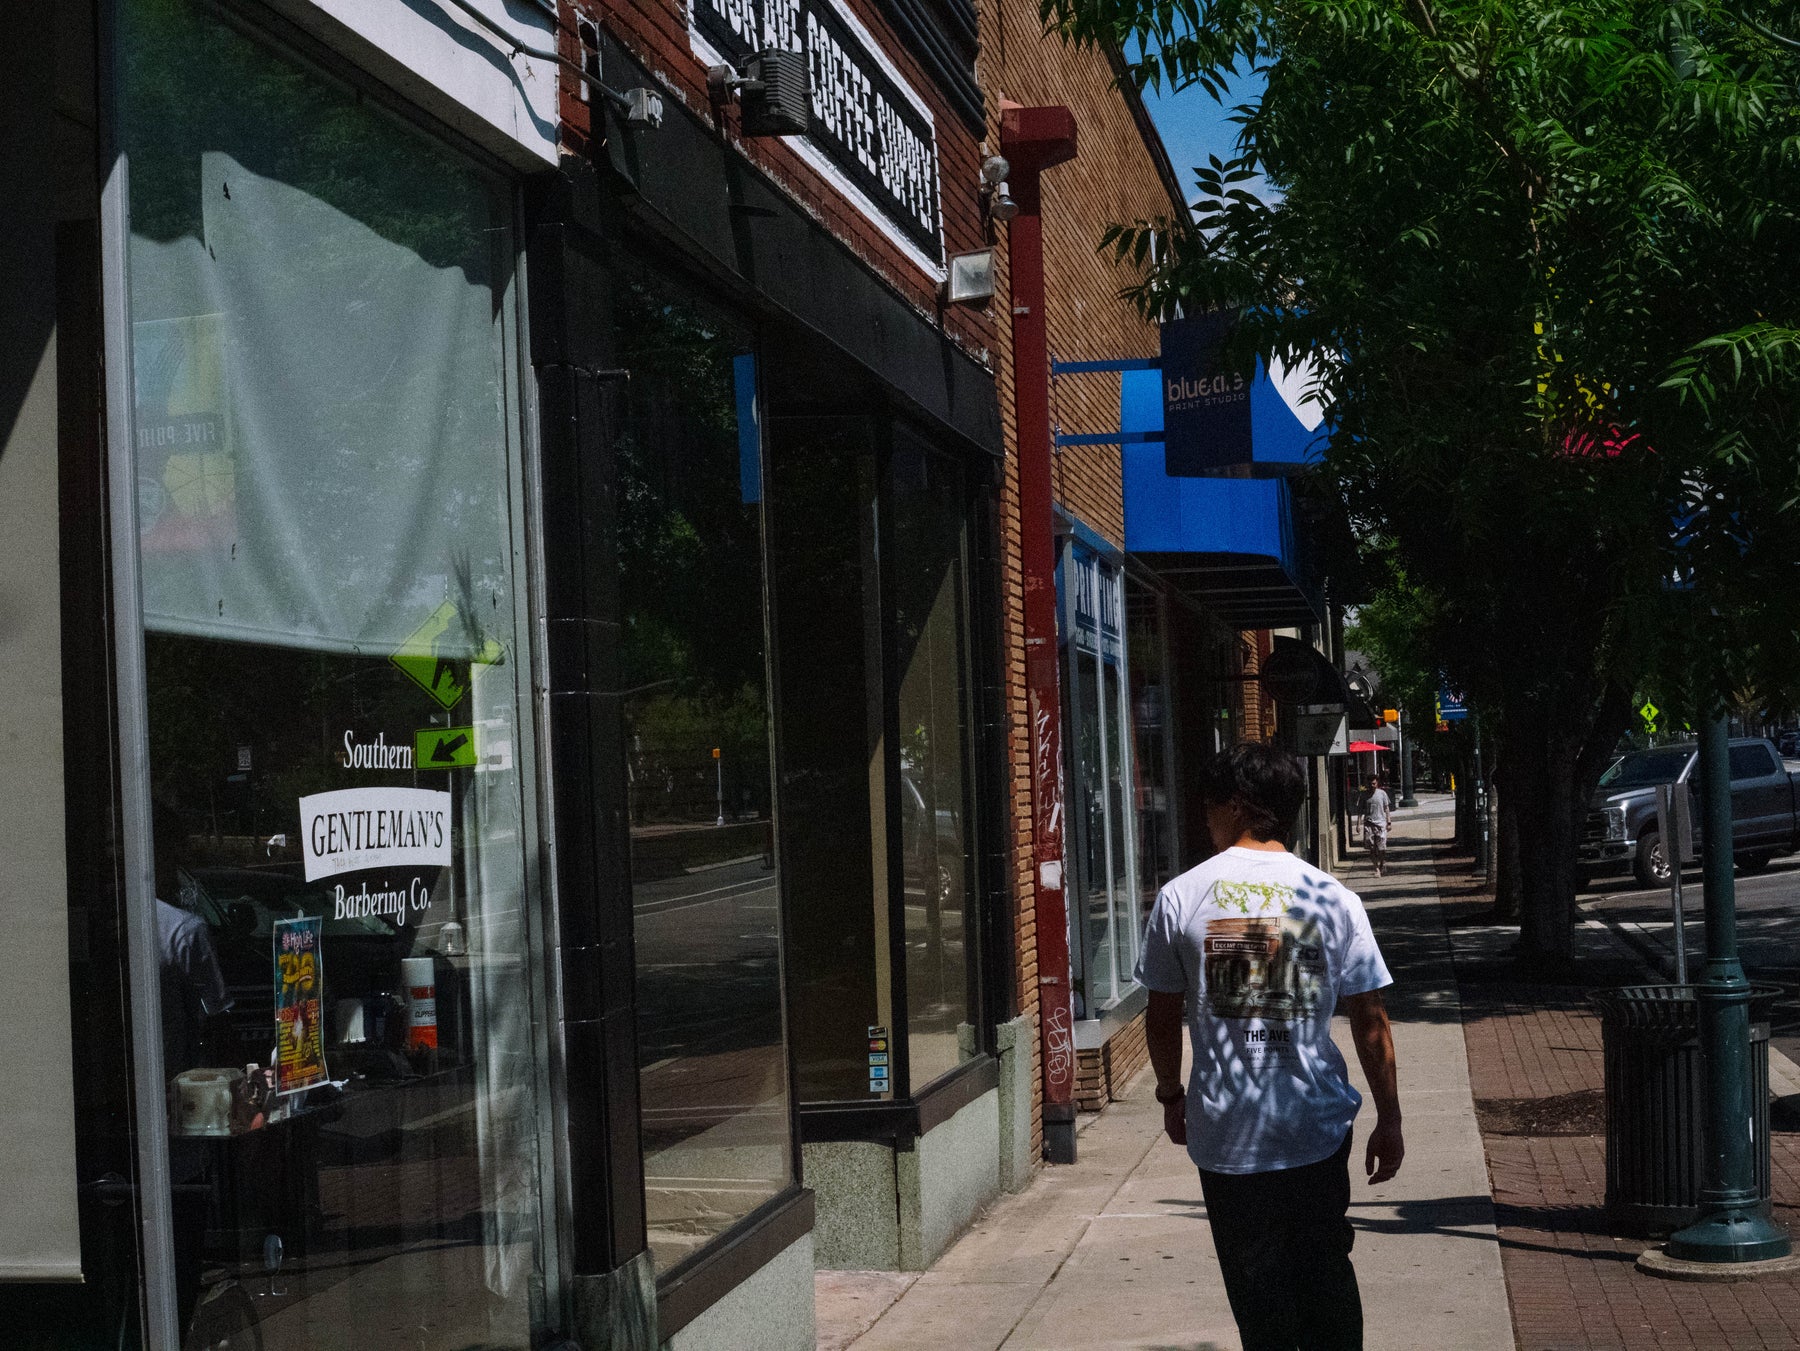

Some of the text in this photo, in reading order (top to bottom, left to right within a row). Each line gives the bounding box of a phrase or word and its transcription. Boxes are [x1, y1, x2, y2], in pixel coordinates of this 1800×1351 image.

[807, 10, 876, 176] COFFEE
[875, 92, 932, 235] SUPPLY
[1168, 400, 1201, 412] PRINT
[343, 730, 413, 770] Southern
[311, 810, 444, 857] GENTLEMAN'S
[334, 877, 432, 927] Barbering Co.
[1244, 1029, 1290, 1042] THE AVE
